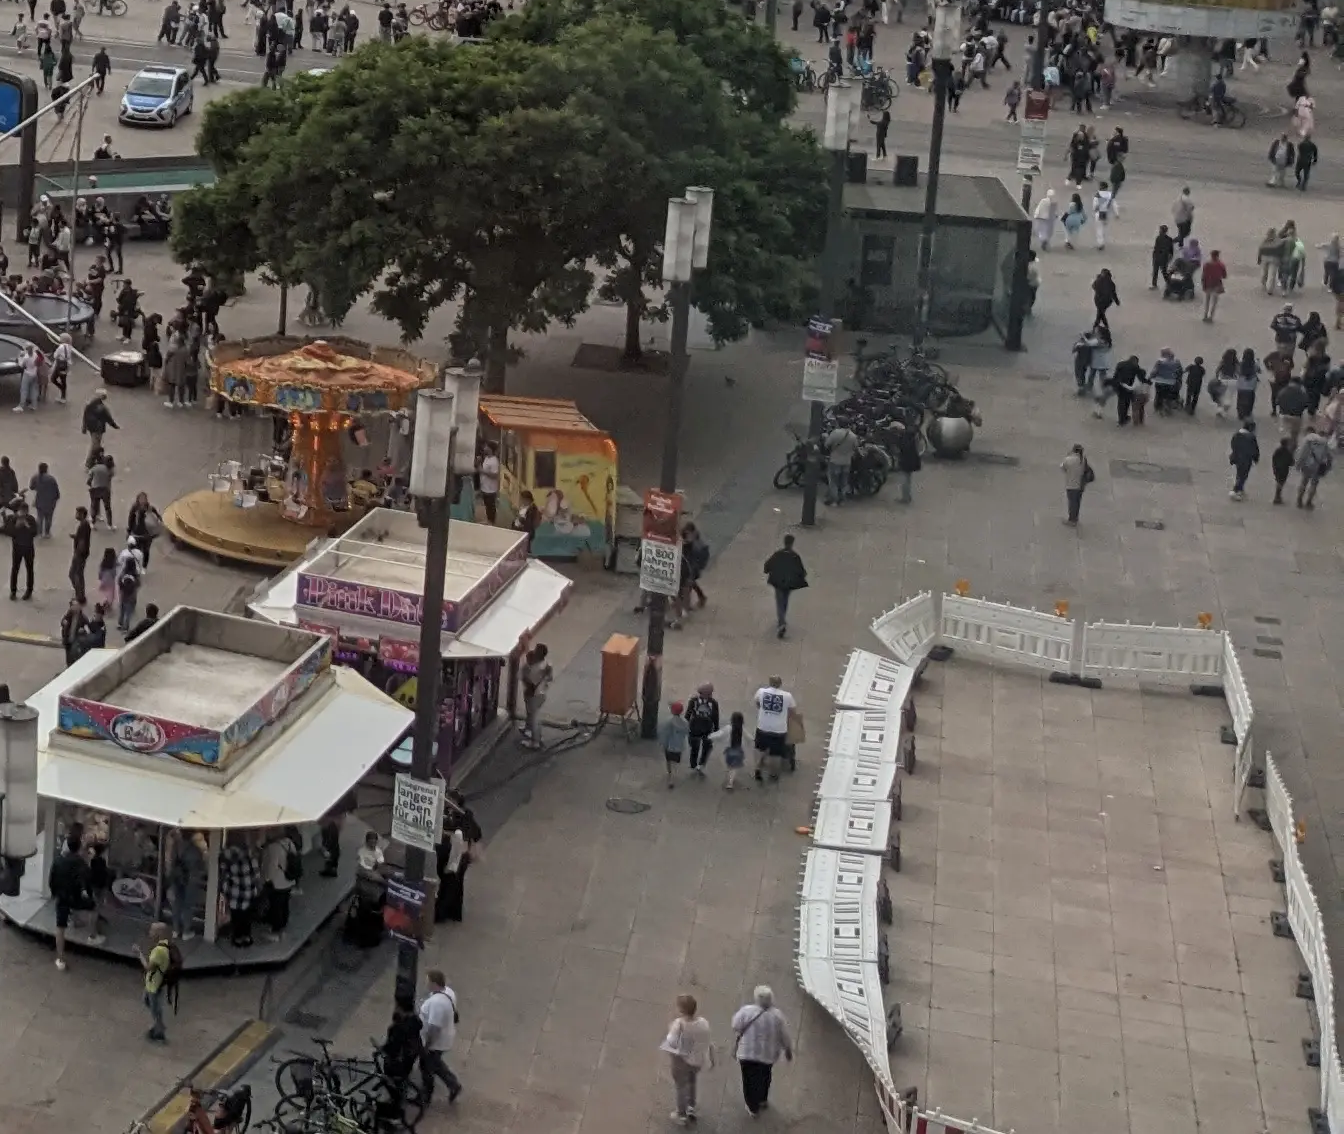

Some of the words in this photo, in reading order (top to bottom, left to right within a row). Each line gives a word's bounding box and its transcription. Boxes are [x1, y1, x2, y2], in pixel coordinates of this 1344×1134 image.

[397, 783, 434, 806] langes
[397, 796, 432, 817] Leben
[412, 814, 433, 829] alle
